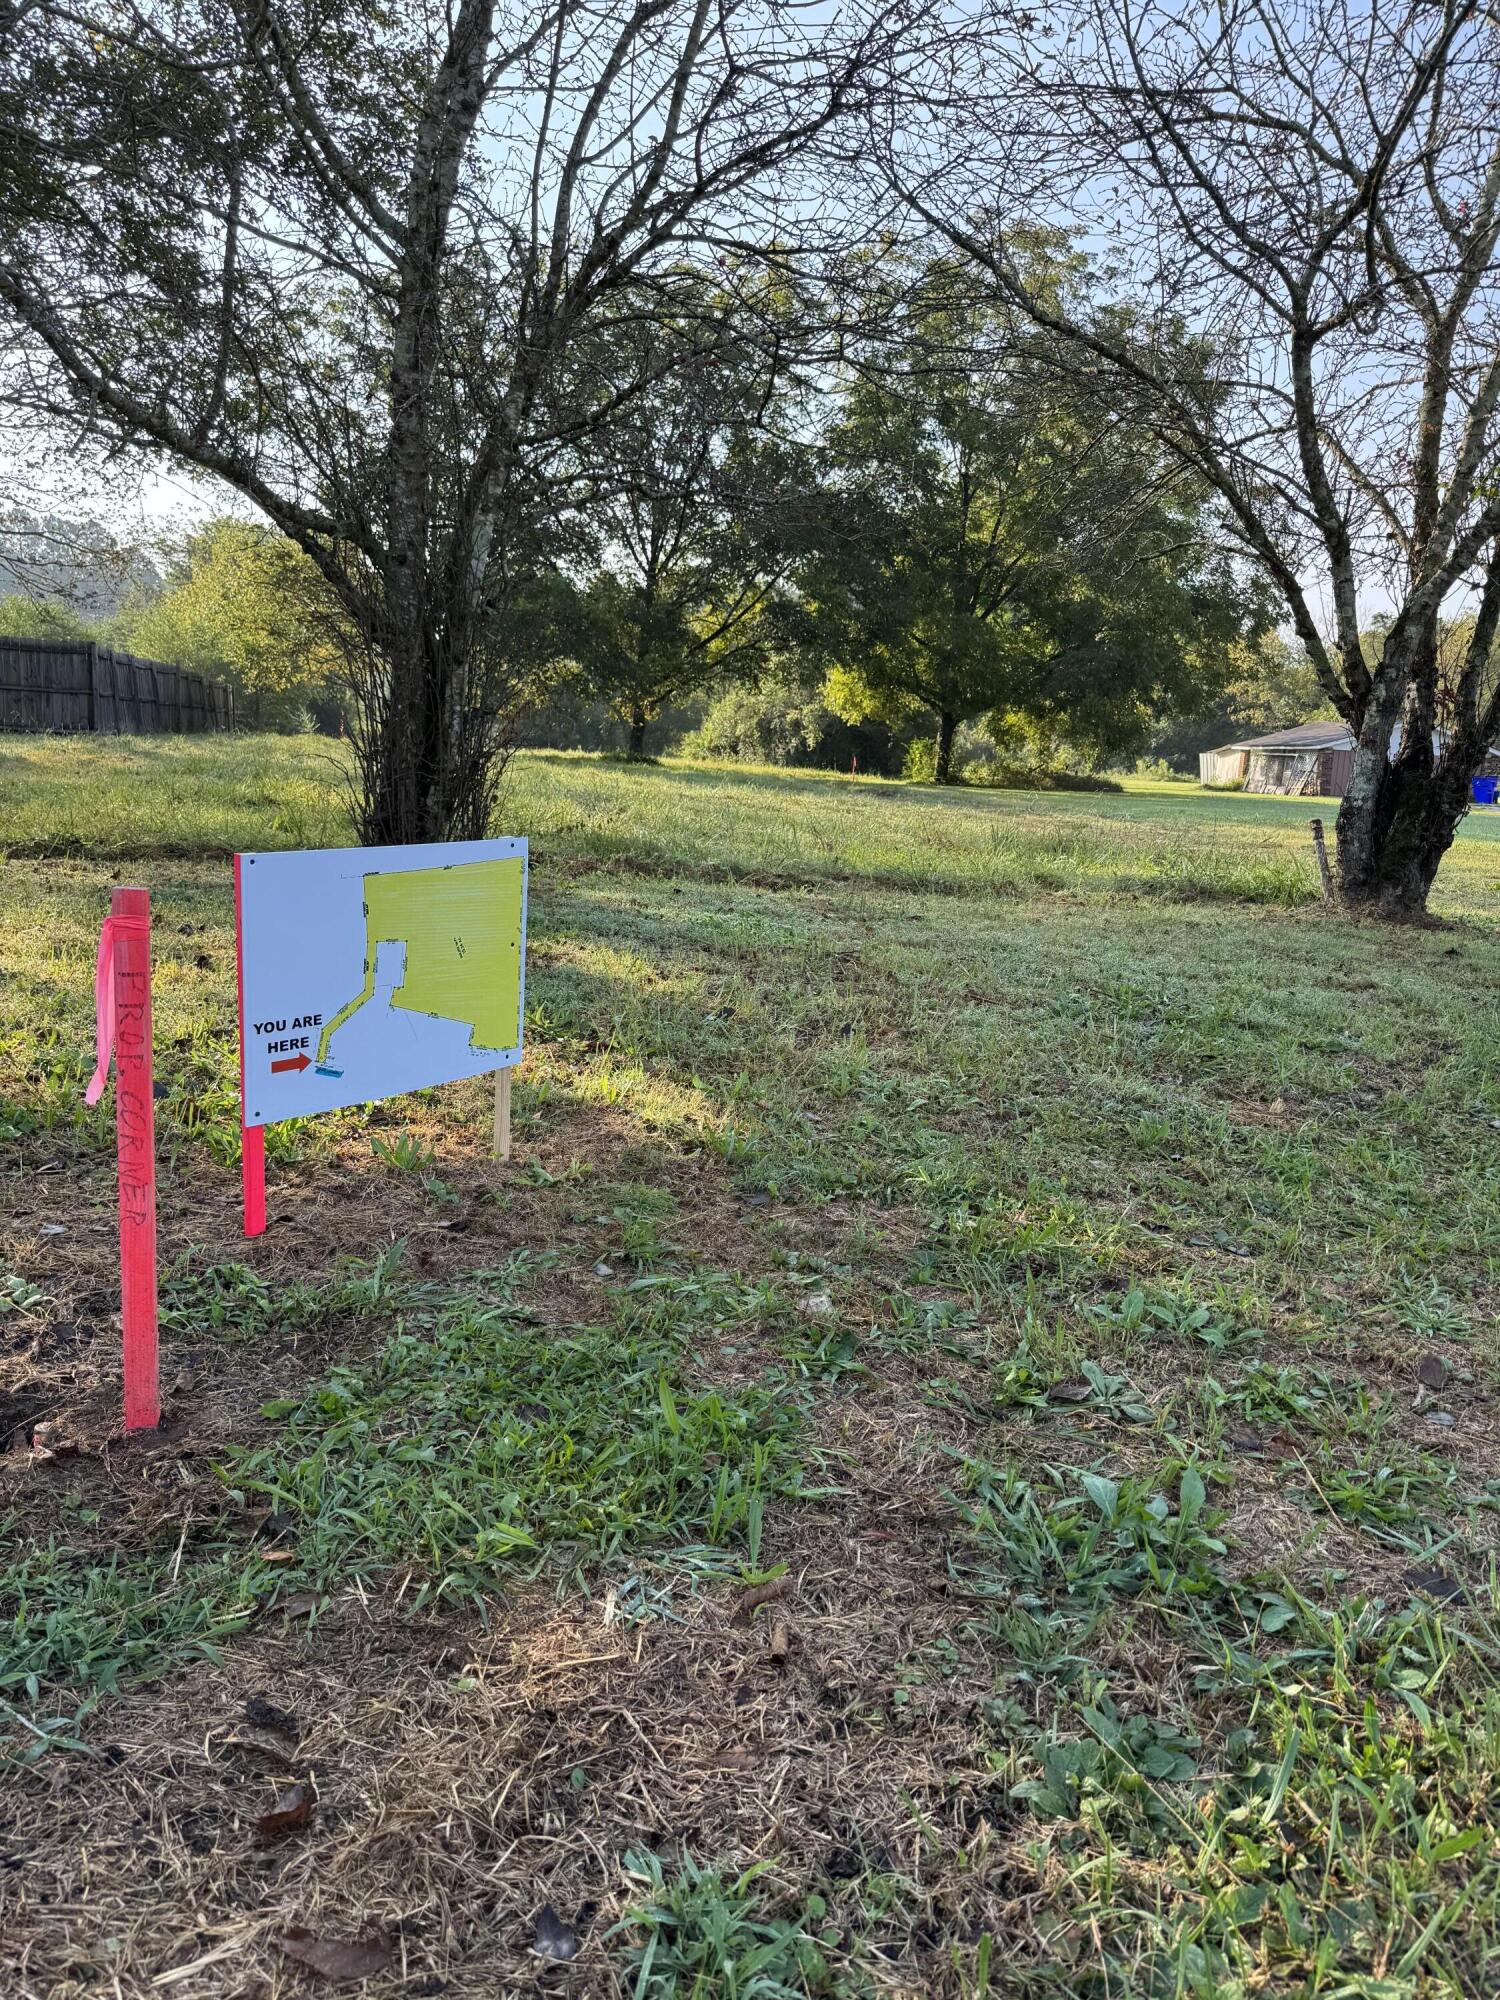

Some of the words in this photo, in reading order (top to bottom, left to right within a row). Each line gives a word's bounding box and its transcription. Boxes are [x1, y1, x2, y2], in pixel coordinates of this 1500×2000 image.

[118, 971, 147, 1077] PROP.
[253, 1019, 287, 1035] YOU
[291, 1013, 323, 1030] ARE
[267, 1036, 310, 1054] HERE
[118, 1090, 148, 1226] CORNER
